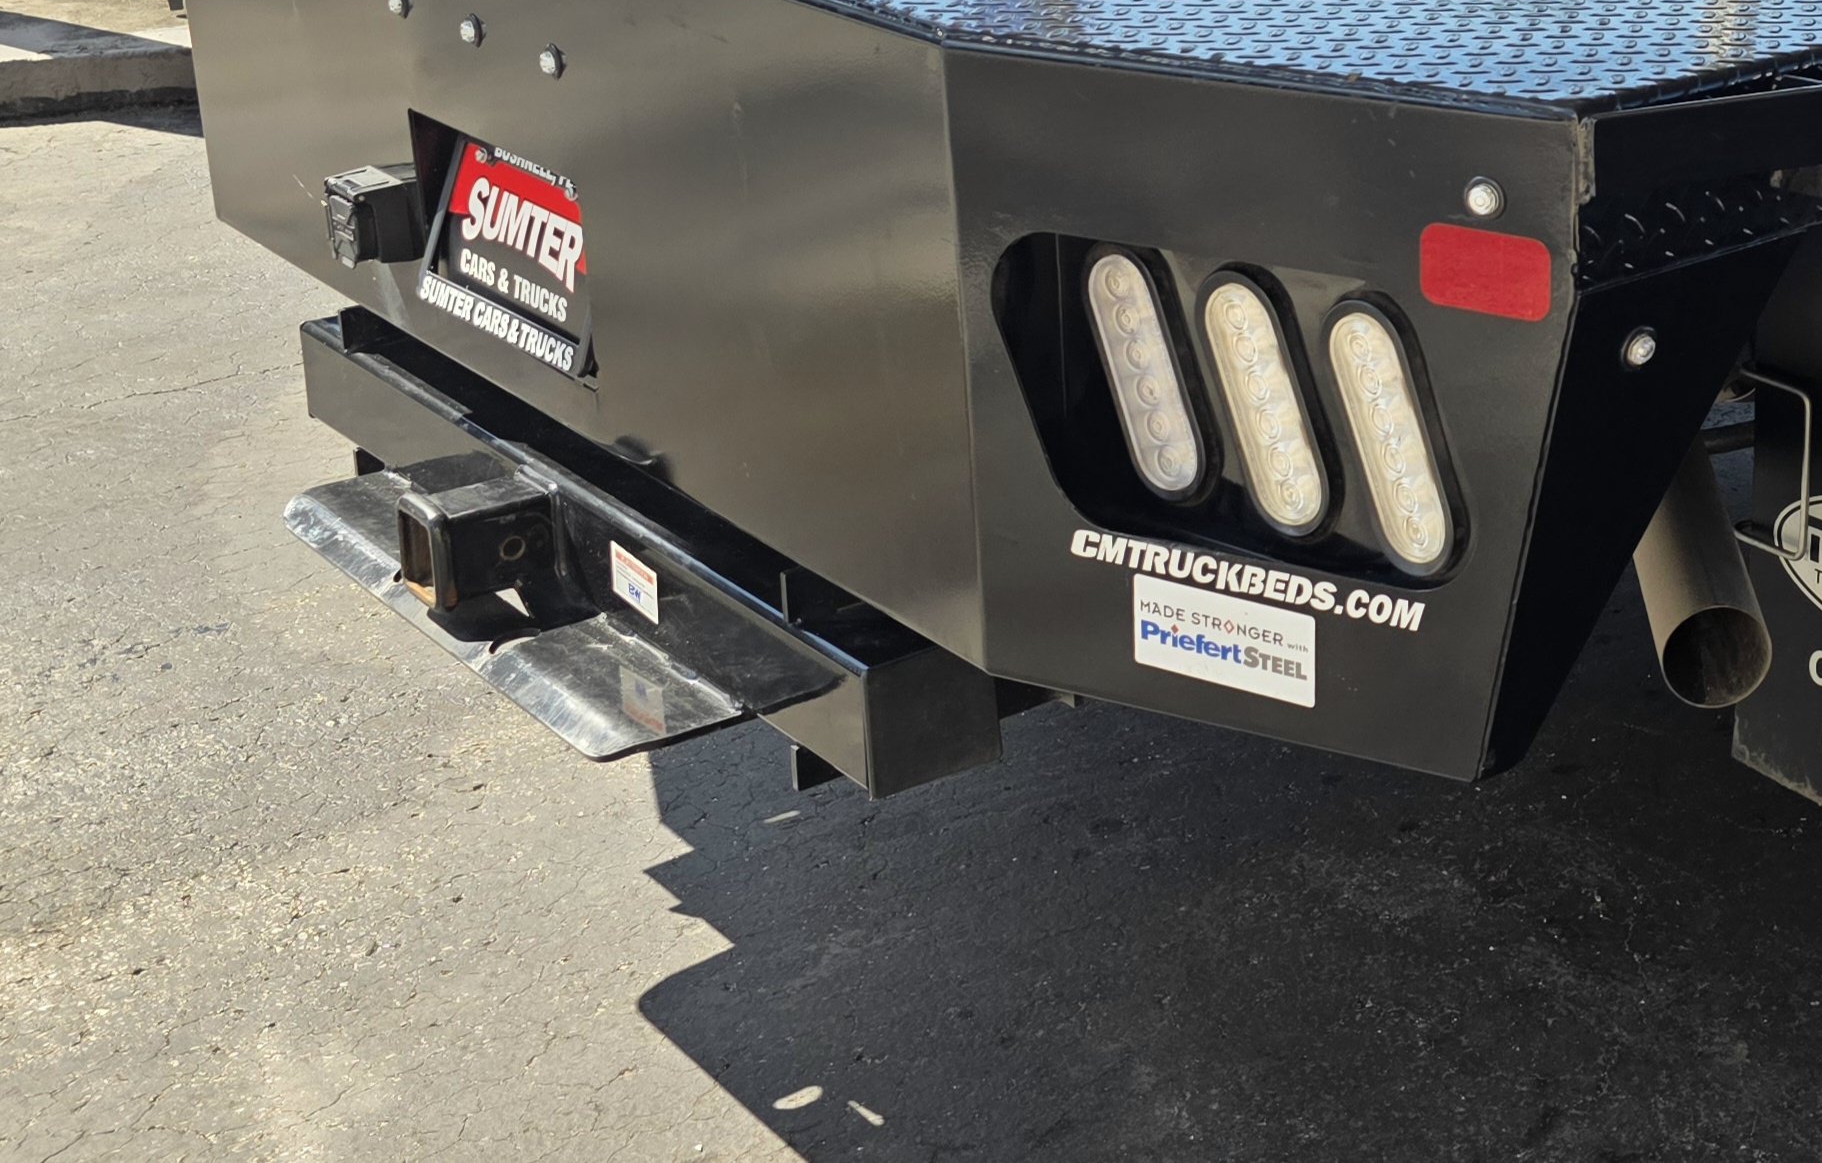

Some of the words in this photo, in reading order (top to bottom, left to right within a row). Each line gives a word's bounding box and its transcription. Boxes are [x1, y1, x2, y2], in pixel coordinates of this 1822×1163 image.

[462, 177, 584, 293] SUMTER
[419, 274, 475, 321] SUMTER
[473, 306, 509, 339] CARS
[506, 317, 519, 344] &
[517, 323, 575, 371] TRUCKS
[460, 248, 496, 287] CARS
[497, 267, 510, 294] &
[513, 274, 568, 323] TRUCKS
[1070, 529, 1426, 632] CMTRUCKBEDS.COM
[1140, 599, 1186, 622] MADE
[1191, 611, 1284, 647] STRONGER
[1287, 642, 1310, 654] with
